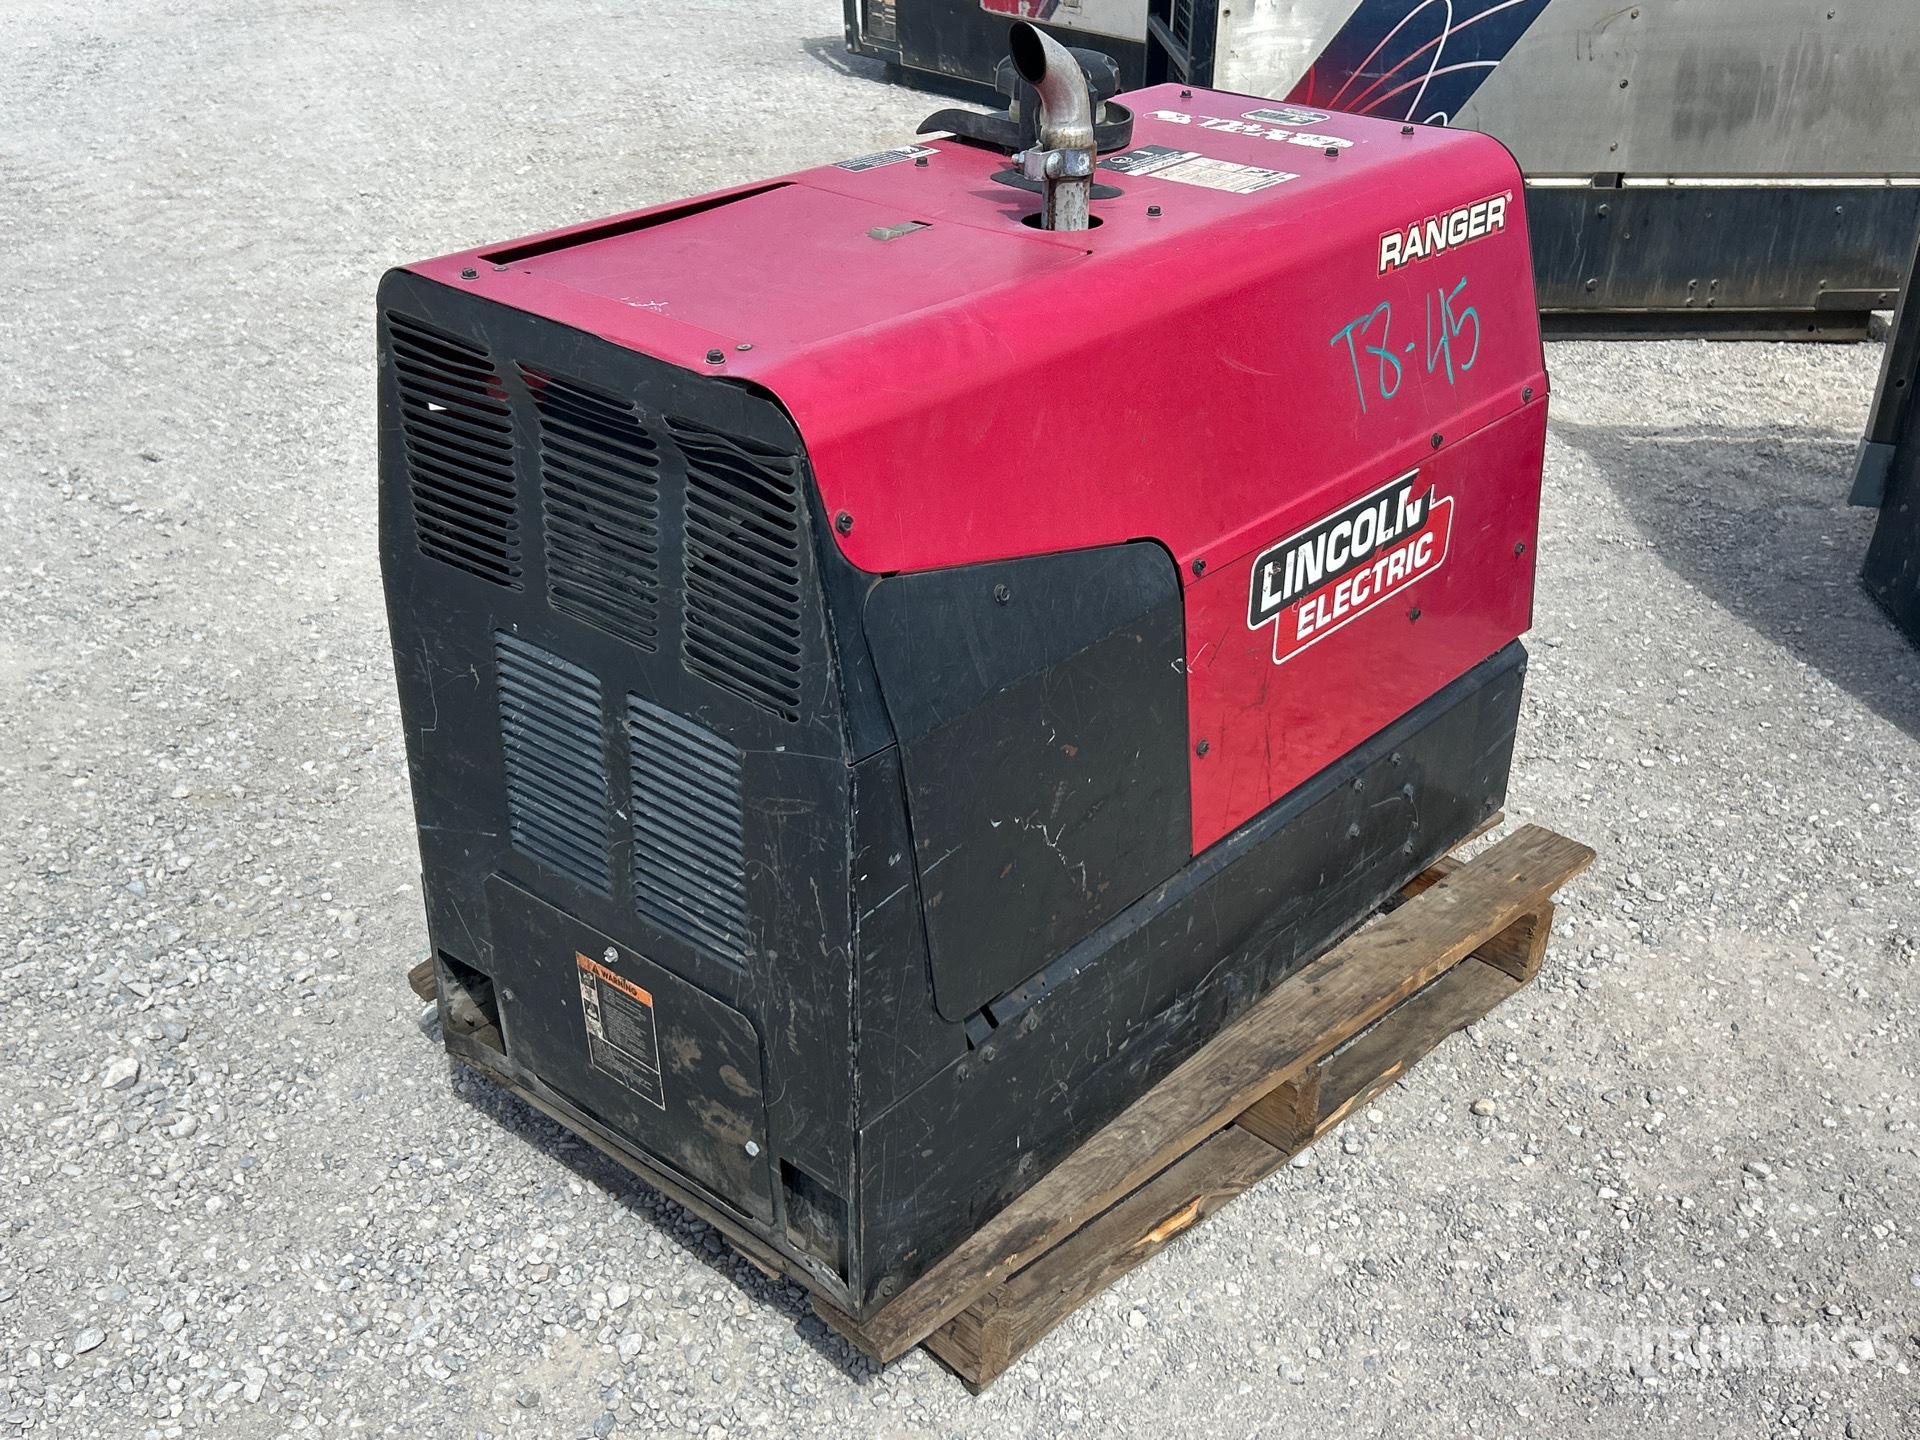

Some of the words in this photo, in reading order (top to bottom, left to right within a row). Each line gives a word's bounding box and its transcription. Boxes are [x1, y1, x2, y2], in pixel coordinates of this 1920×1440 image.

[1378, 194, 1508, 275] RANGER
[1259, 485, 1424, 613] LINCOLN
[1296, 531, 1434, 641] ELECTRIC
[600, 968, 638, 997] WARNING
